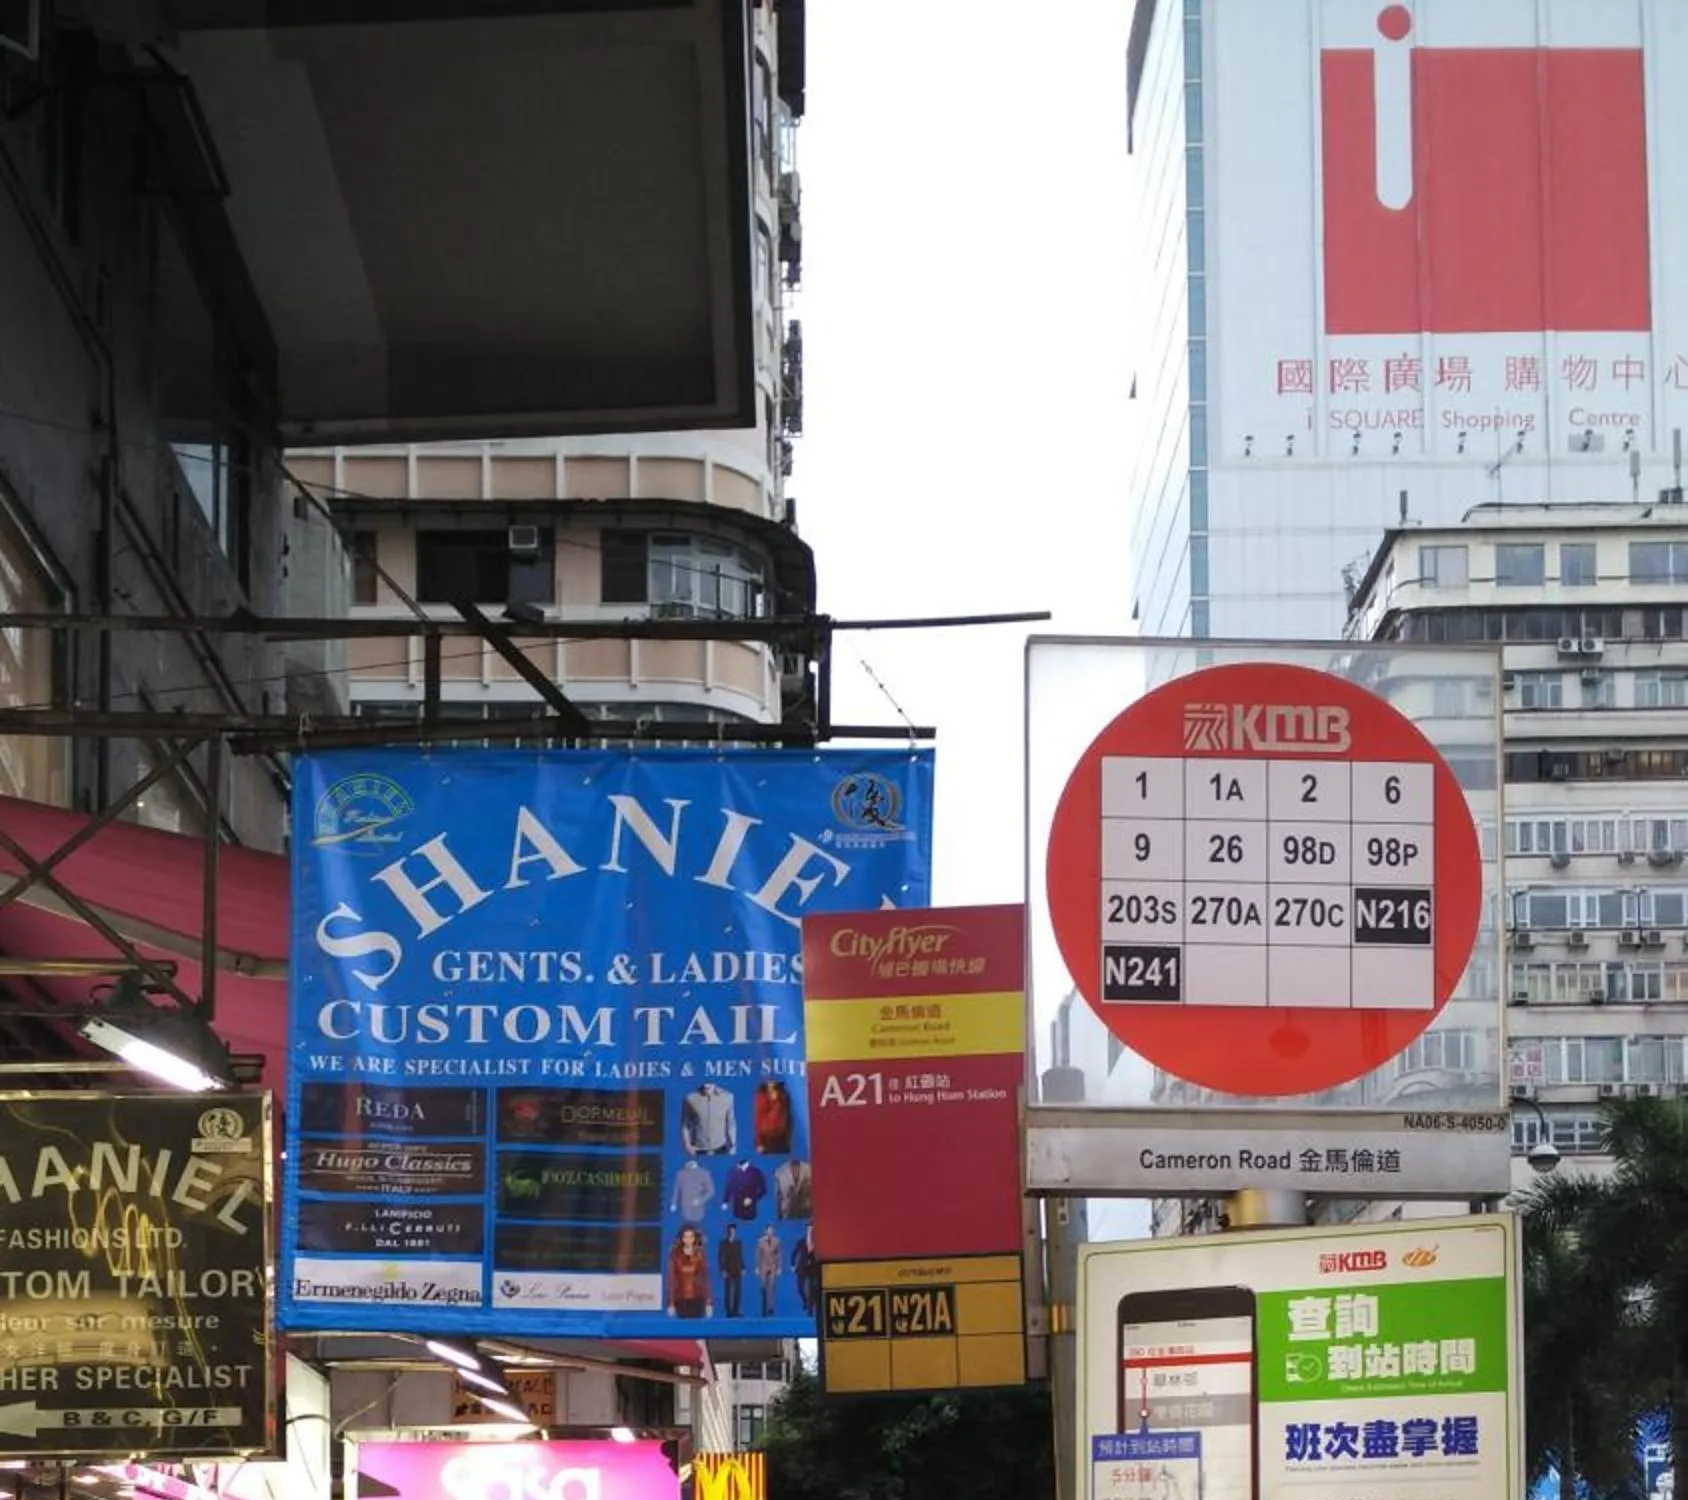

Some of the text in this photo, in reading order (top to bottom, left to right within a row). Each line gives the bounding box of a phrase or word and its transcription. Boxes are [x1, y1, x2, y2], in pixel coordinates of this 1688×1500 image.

[1277, 353, 1472, 395] 國際廣場
[1442, 410, 1536, 433] Shopping
[1569, 407, 1640, 427] Centre
[1136, 771, 1401, 804] 1 1A 2 6
[1135, 833, 1418, 867] 9 26 98D 98P
[315, 794, 898, 991] SHANIE
[1108, 896, 1430, 930] 203S 270A 270C N216
[433, 951, 594, 984] GENTS.
[607, 952, 638, 985] &
[1105, 958, 1179, 987] N241
[317, 999, 615, 1047] CUSTOM
[310, 1055, 343, 1071] WE
[354, 1056, 396, 1074] ARE
[404, 1058, 532, 1075] SPECIALIST
[541, 1059, 585, 1076] FOR
[595, 1061, 671, 1078] LADIES
[681, 1062, 694, 1077] &
[705, 1060, 751, 1077] MEN
[820, 1072, 883, 1107] A21
[967, 1088, 1007, 1100] Station
[356, 1097, 425, 1119] REDA
[316, 1152, 472, 1172] Hugo Classics
[1140, 1149, 1401, 1173] Cameron Road 金馬倫道
[118, 1269, 254, 1299] TAILOR
[296, 1279, 481, 1307] Ermenegildo Zegna
[122, 1315, 220, 1330] mesure
[1288, 1294, 1379, 1341] 查詢
[1328, 1338, 1476, 1380] 到站時間
[76, 1365, 252, 1390] SPECIALIST
[64, 1411, 80, 1426] B
[92, 1411, 112, 1426] &
[163, 1410, 218, 1428] G/F
[1286, 1416, 1479, 1461] 班次盡掌握
